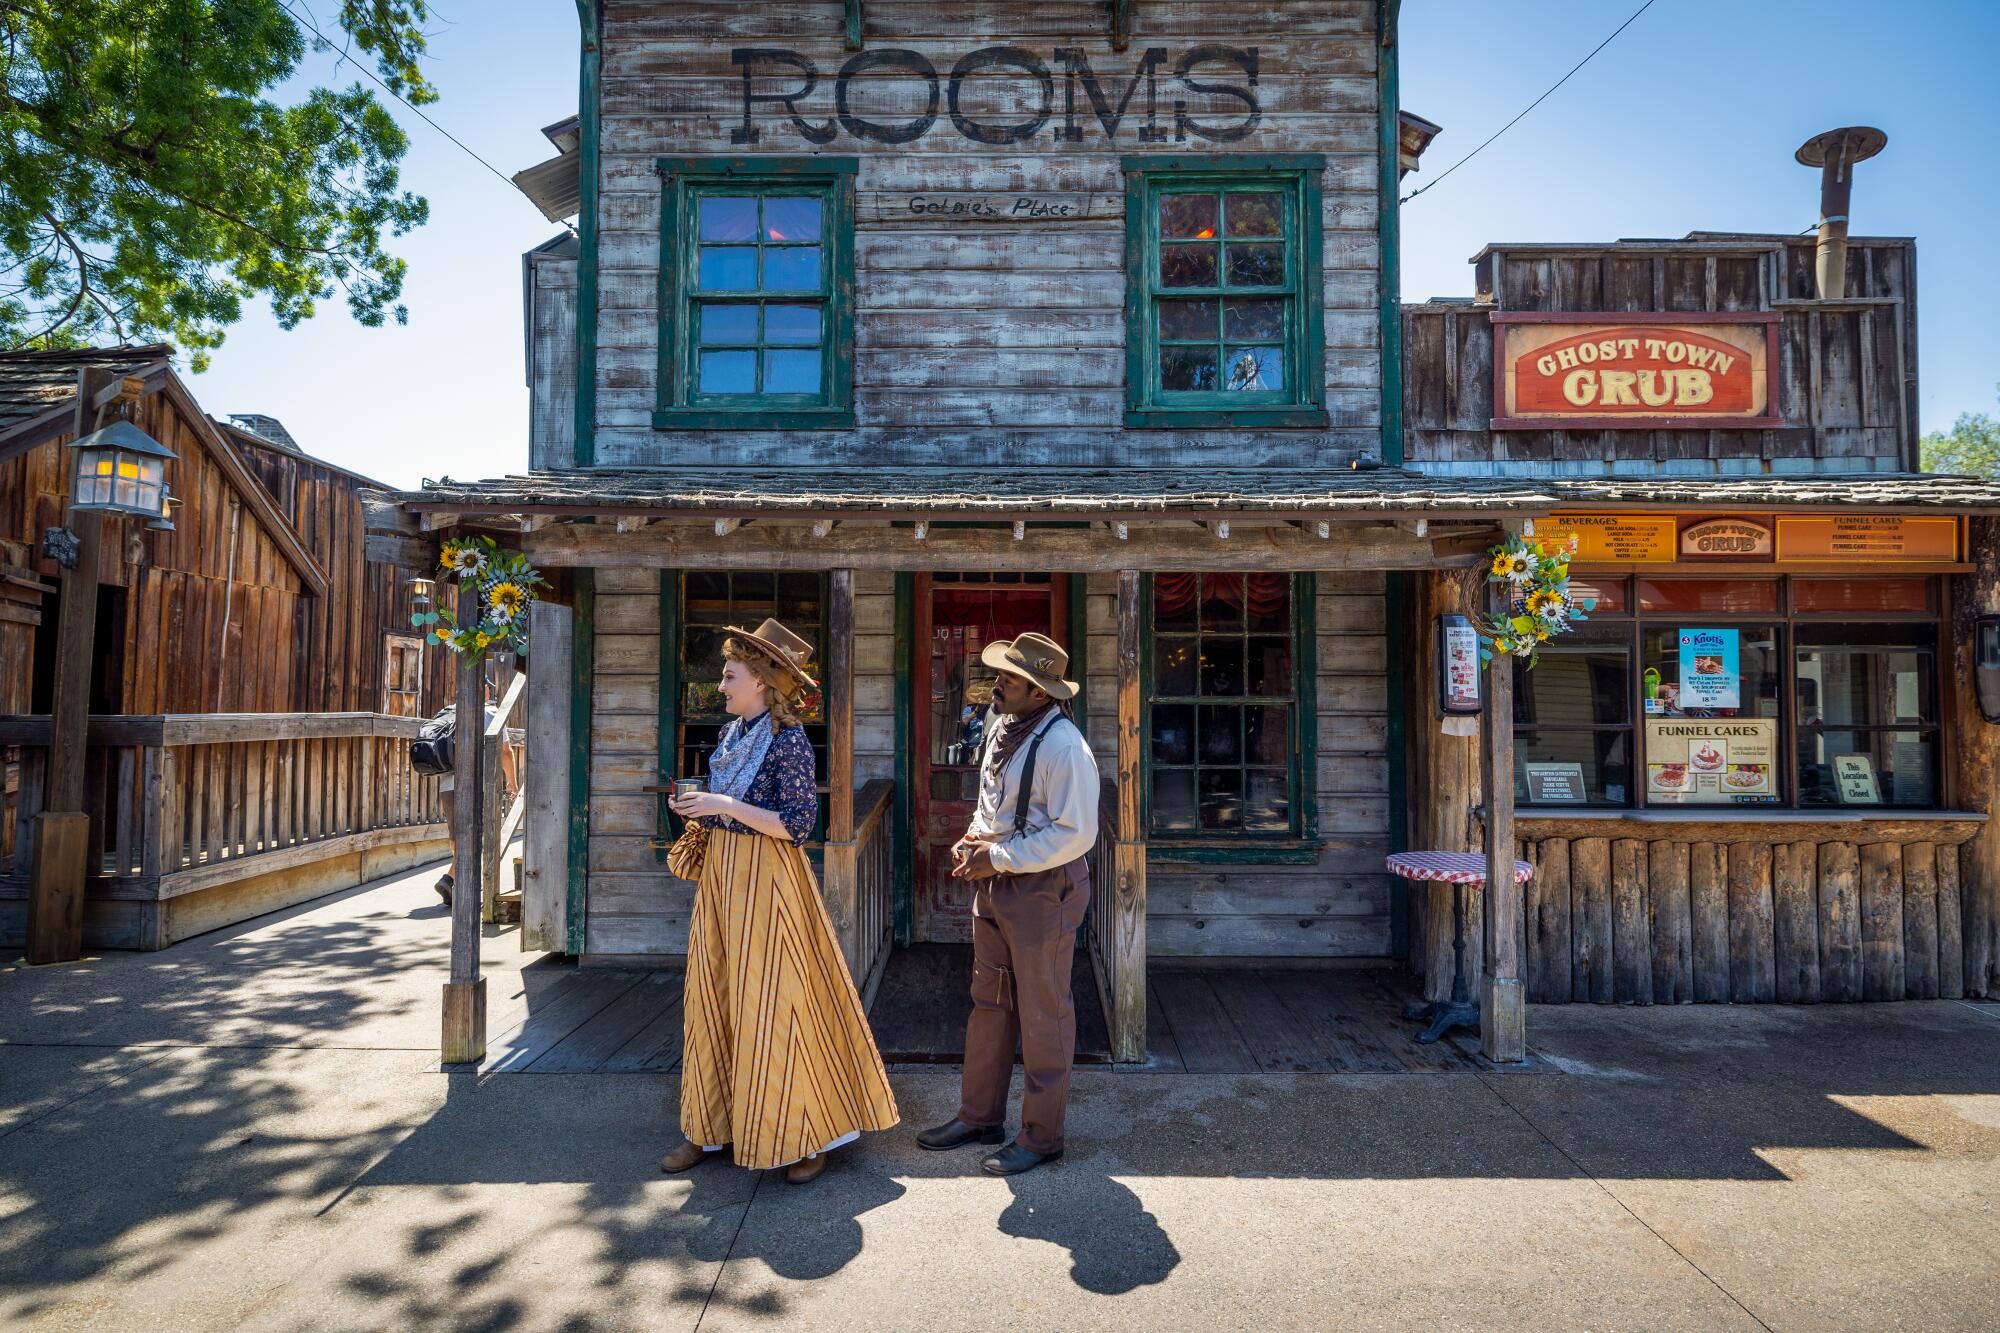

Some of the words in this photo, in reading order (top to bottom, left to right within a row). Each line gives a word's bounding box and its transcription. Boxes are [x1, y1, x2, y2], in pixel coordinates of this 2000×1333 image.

[730, 45, 1262, 145] ROOMS
[1537, 339, 1639, 376] GHOST
[1645, 339, 1735, 376] TOWN
[1562, 369, 1714, 407] GRUB
[1688, 525, 1728, 540] GHOST
[1729, 525, 1765, 540] TOWN
[1698, 537, 1756, 552] GRUB
[1694, 632, 1724, 646] Knott's
[1658, 726, 1711, 736] FUNNEL
[1714, 726, 1758, 736] CAKES
[1849, 789, 1870, 797] Closed
